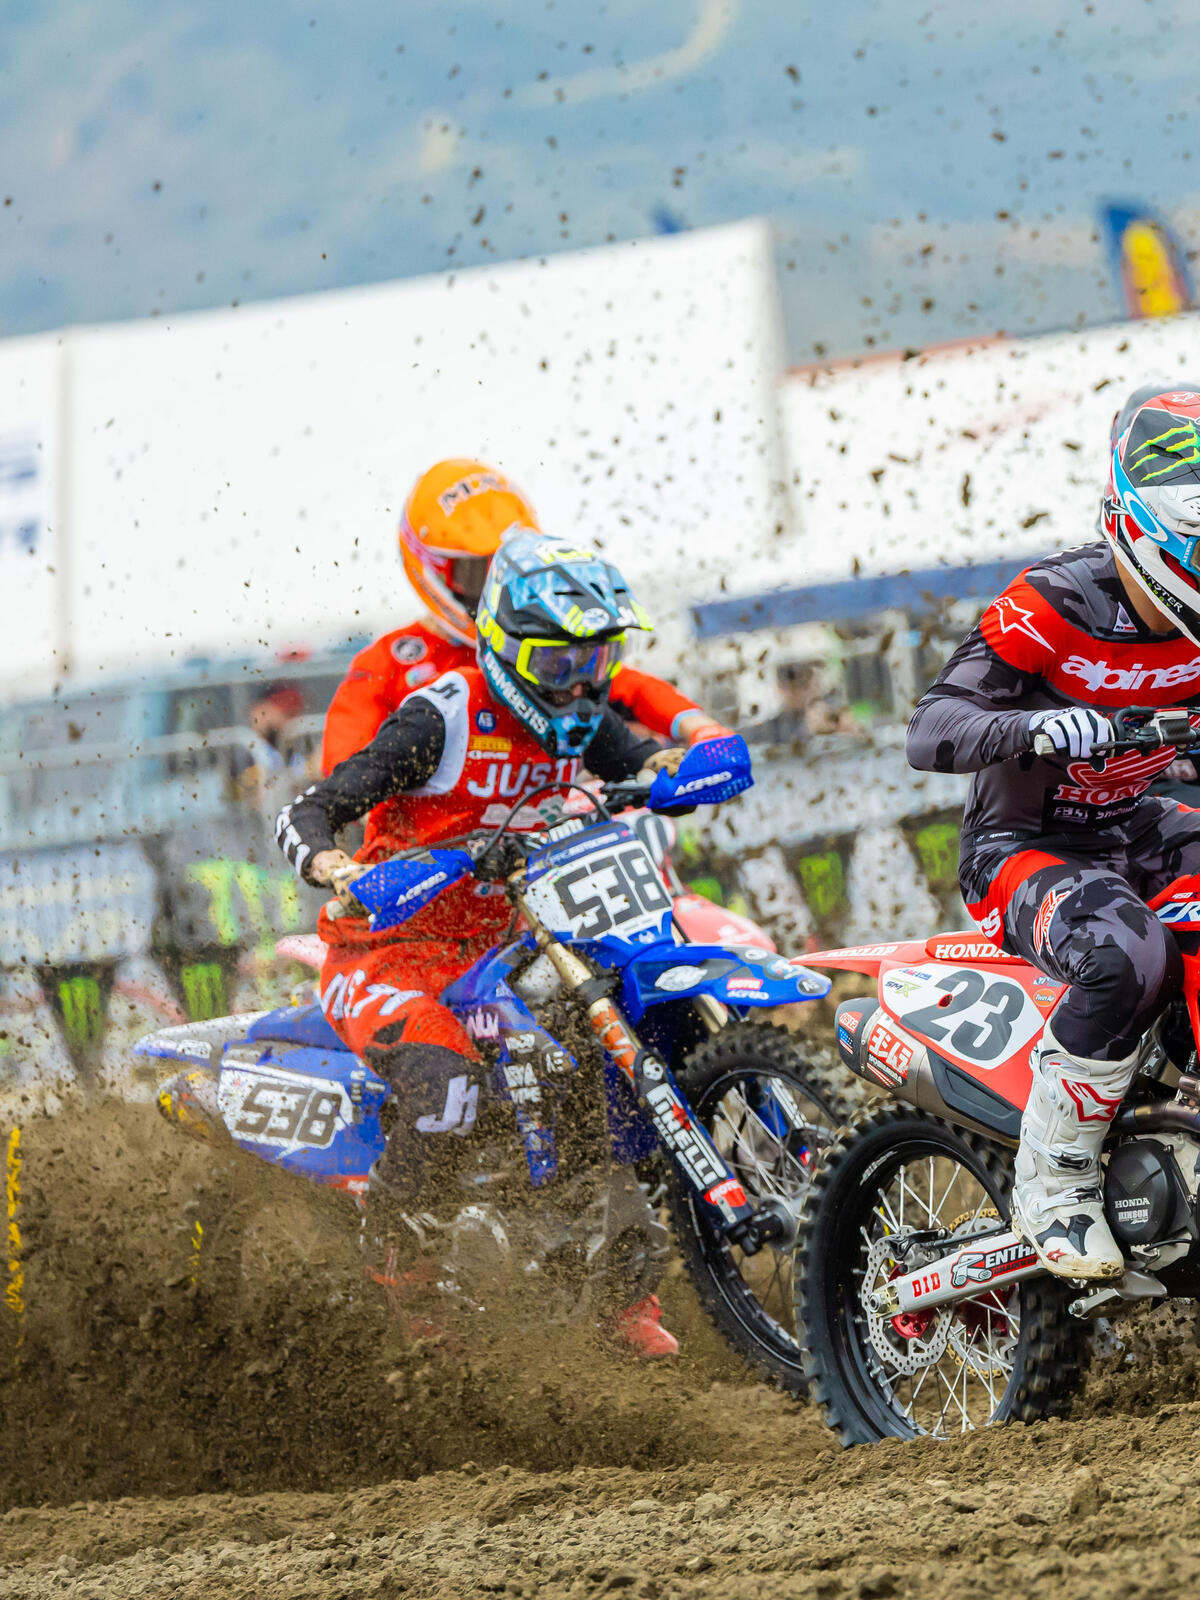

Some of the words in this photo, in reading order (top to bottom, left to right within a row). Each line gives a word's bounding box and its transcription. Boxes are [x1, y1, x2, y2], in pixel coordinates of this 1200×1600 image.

[553, 850, 672, 939] 538
[935, 943, 1015, 959] HONDA
[901, 970, 1025, 1061] 23
[235, 1080, 342, 1146] 538
[1115, 1198, 1150, 1209] HONDA
